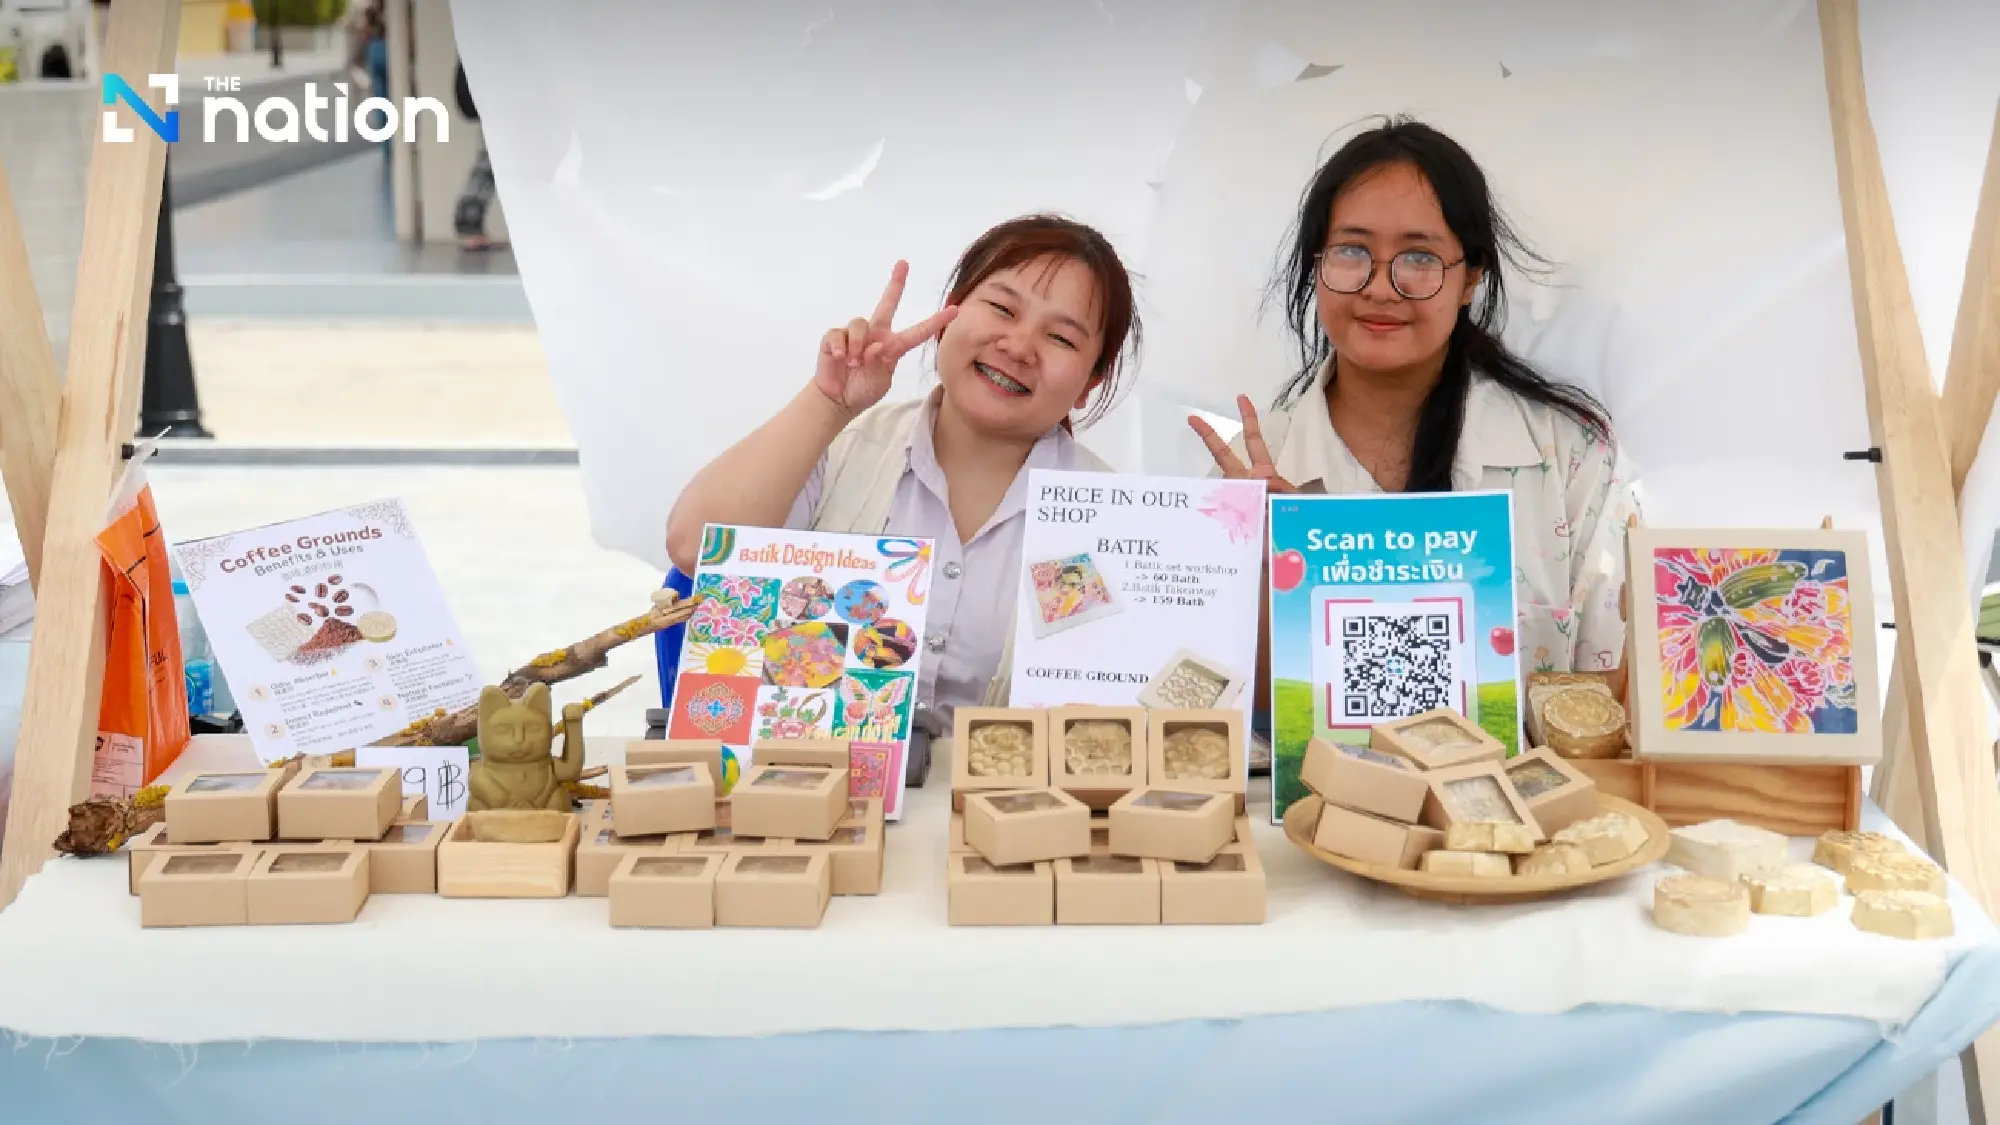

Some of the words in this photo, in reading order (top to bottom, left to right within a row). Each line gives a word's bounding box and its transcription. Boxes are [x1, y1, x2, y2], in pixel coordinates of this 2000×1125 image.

[1039, 485, 1104, 504] PRICE
[1110, 488, 1134, 506] IN
[1142, 490, 1189, 508] OUR
[1037, 506, 1098, 524] SHOP
[219, 543, 293, 574] Coffee
[296, 525, 383, 550] Grounds
[1096, 536, 1160, 557] BATIK
[1306, 528, 1375, 551] Scan
[1384, 529, 1415, 551] to
[1424, 529, 1478, 556] pay
[254, 551, 313, 577] Benefits
[316, 547, 327, 560] &
[330, 543, 364, 557] Uses
[739, 543, 779, 564] Batik
[782, 542, 835, 574] Design
[836, 548, 877, 570] Ideas
[1322, 553, 1464, 583] เพื่อชำระเงิน
[1171, 574, 1200, 584] Bath
[1185, 563, 1238, 577] workshop
[1176, 596, 1205, 607] Bath
[1025, 666, 1083, 681] COFFEE
[1085, 671, 1149, 684] GROUND
